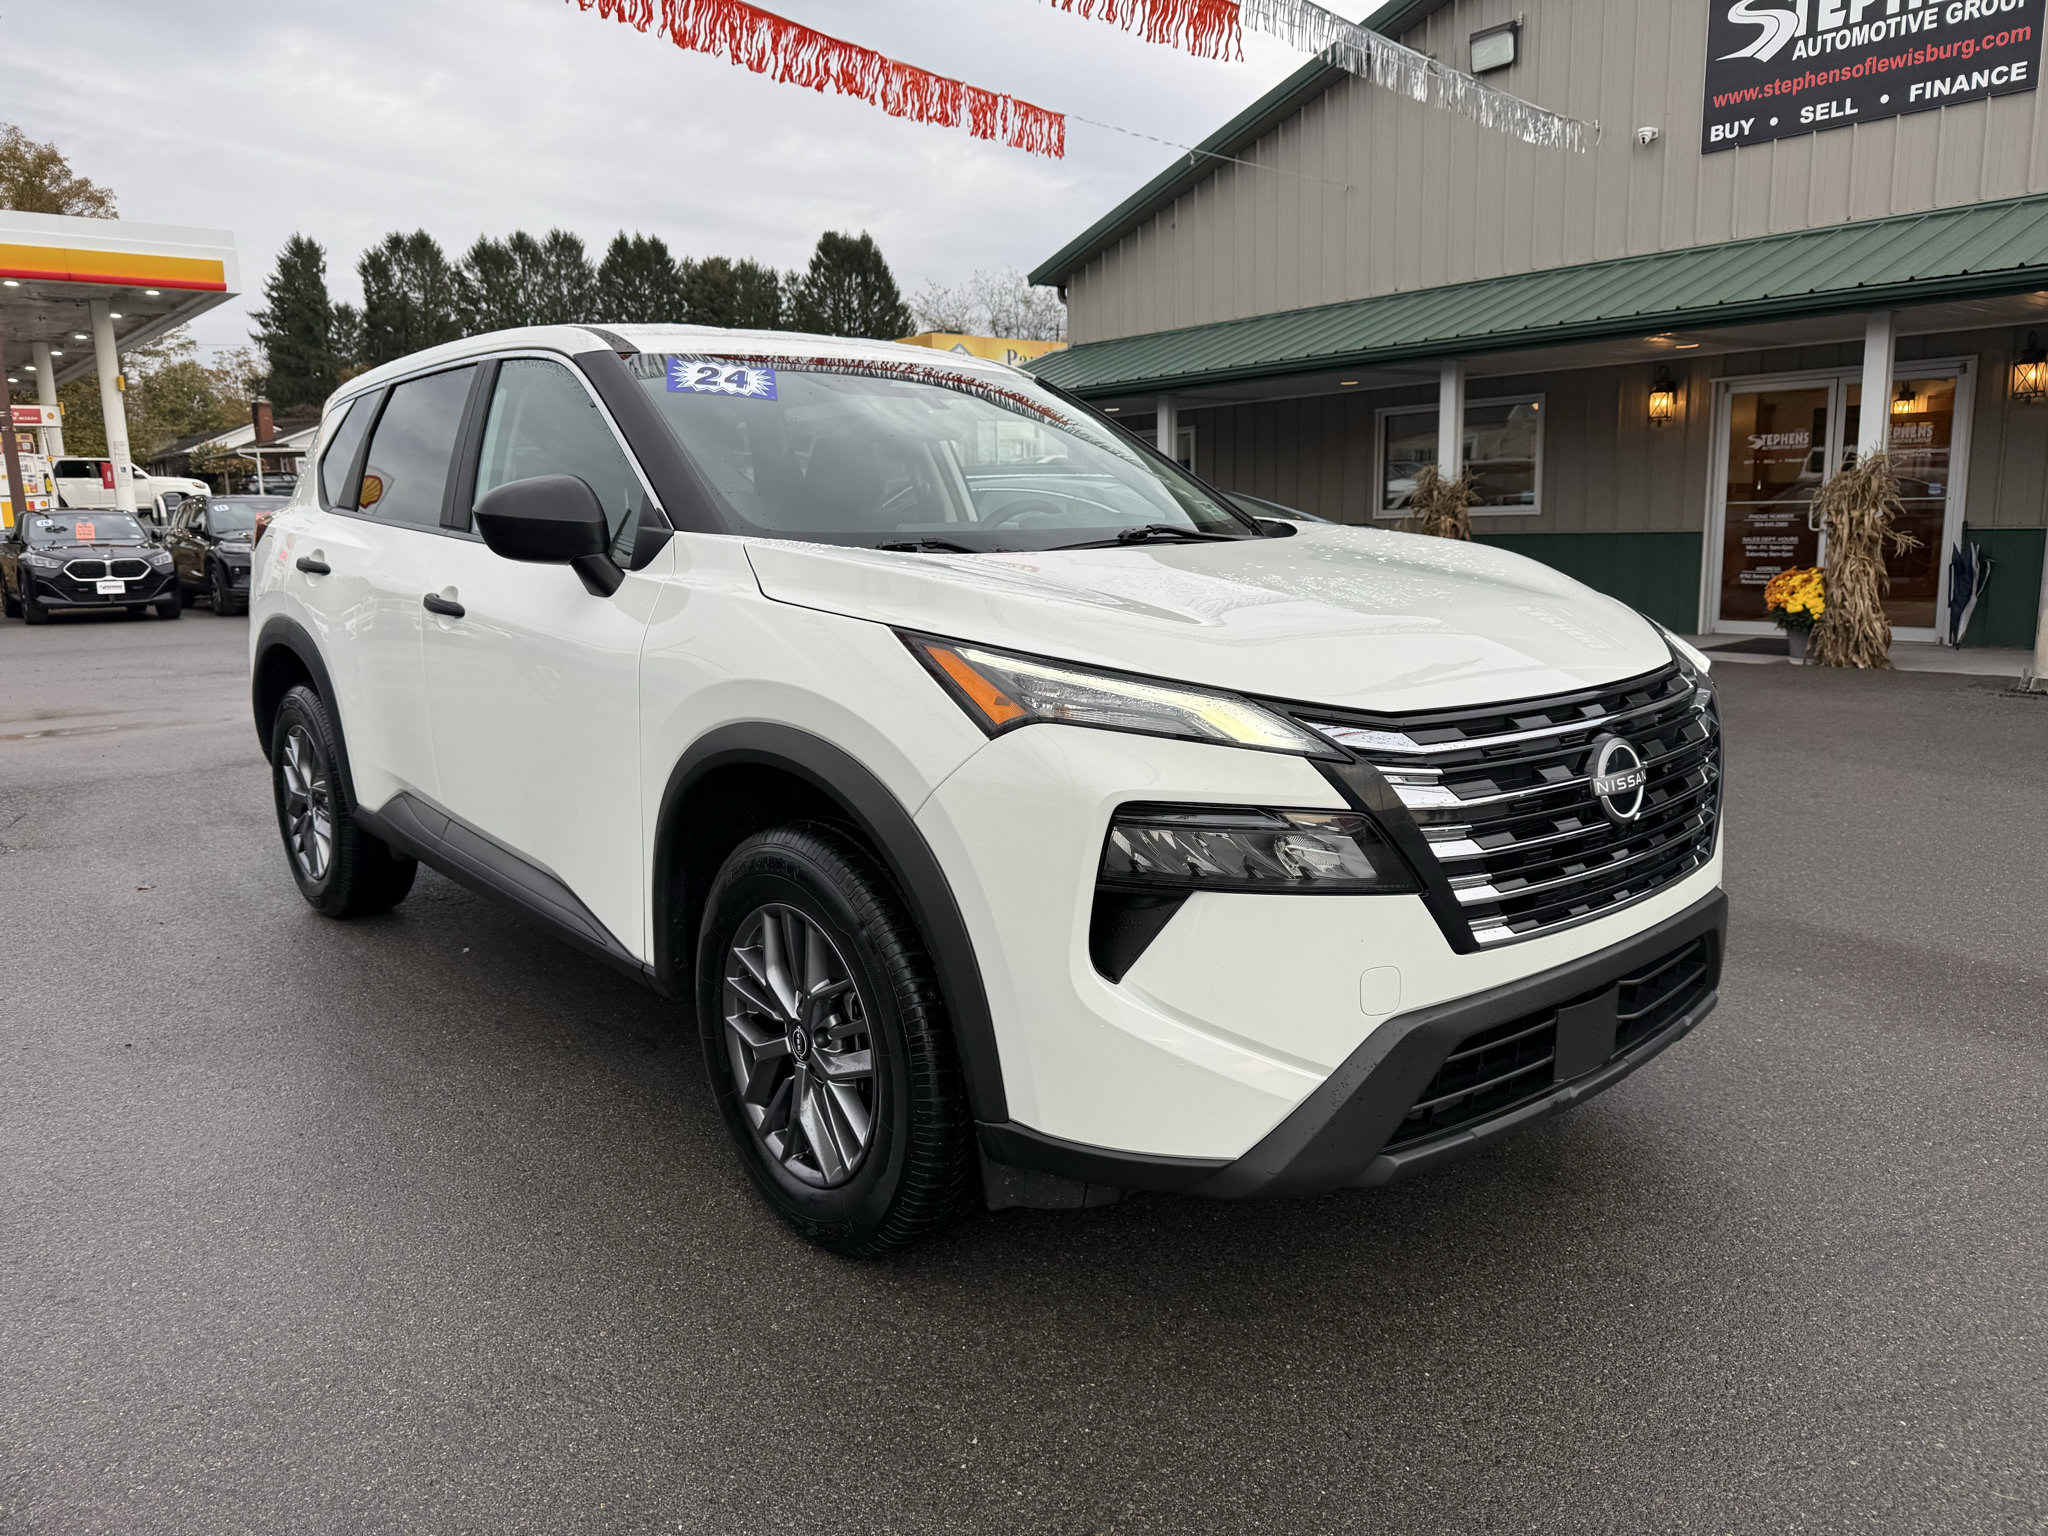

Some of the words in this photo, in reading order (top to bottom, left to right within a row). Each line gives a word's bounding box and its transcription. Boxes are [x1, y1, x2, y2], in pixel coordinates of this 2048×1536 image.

[1792, 8, 1938, 61] AUTOMOTIVE
[1713, 26, 2031, 108] www.stephensoflewisburg.com
[1710, 118, 1755, 142] BUY
[1800, 98, 1858, 124] SELL
[1909, 61, 2028, 103] FINANCE
[694, 366, 749, 389] 24
[1746, 432, 1810, 449] STEPHENS
[1596, 769, 1647, 793] NISSAN
